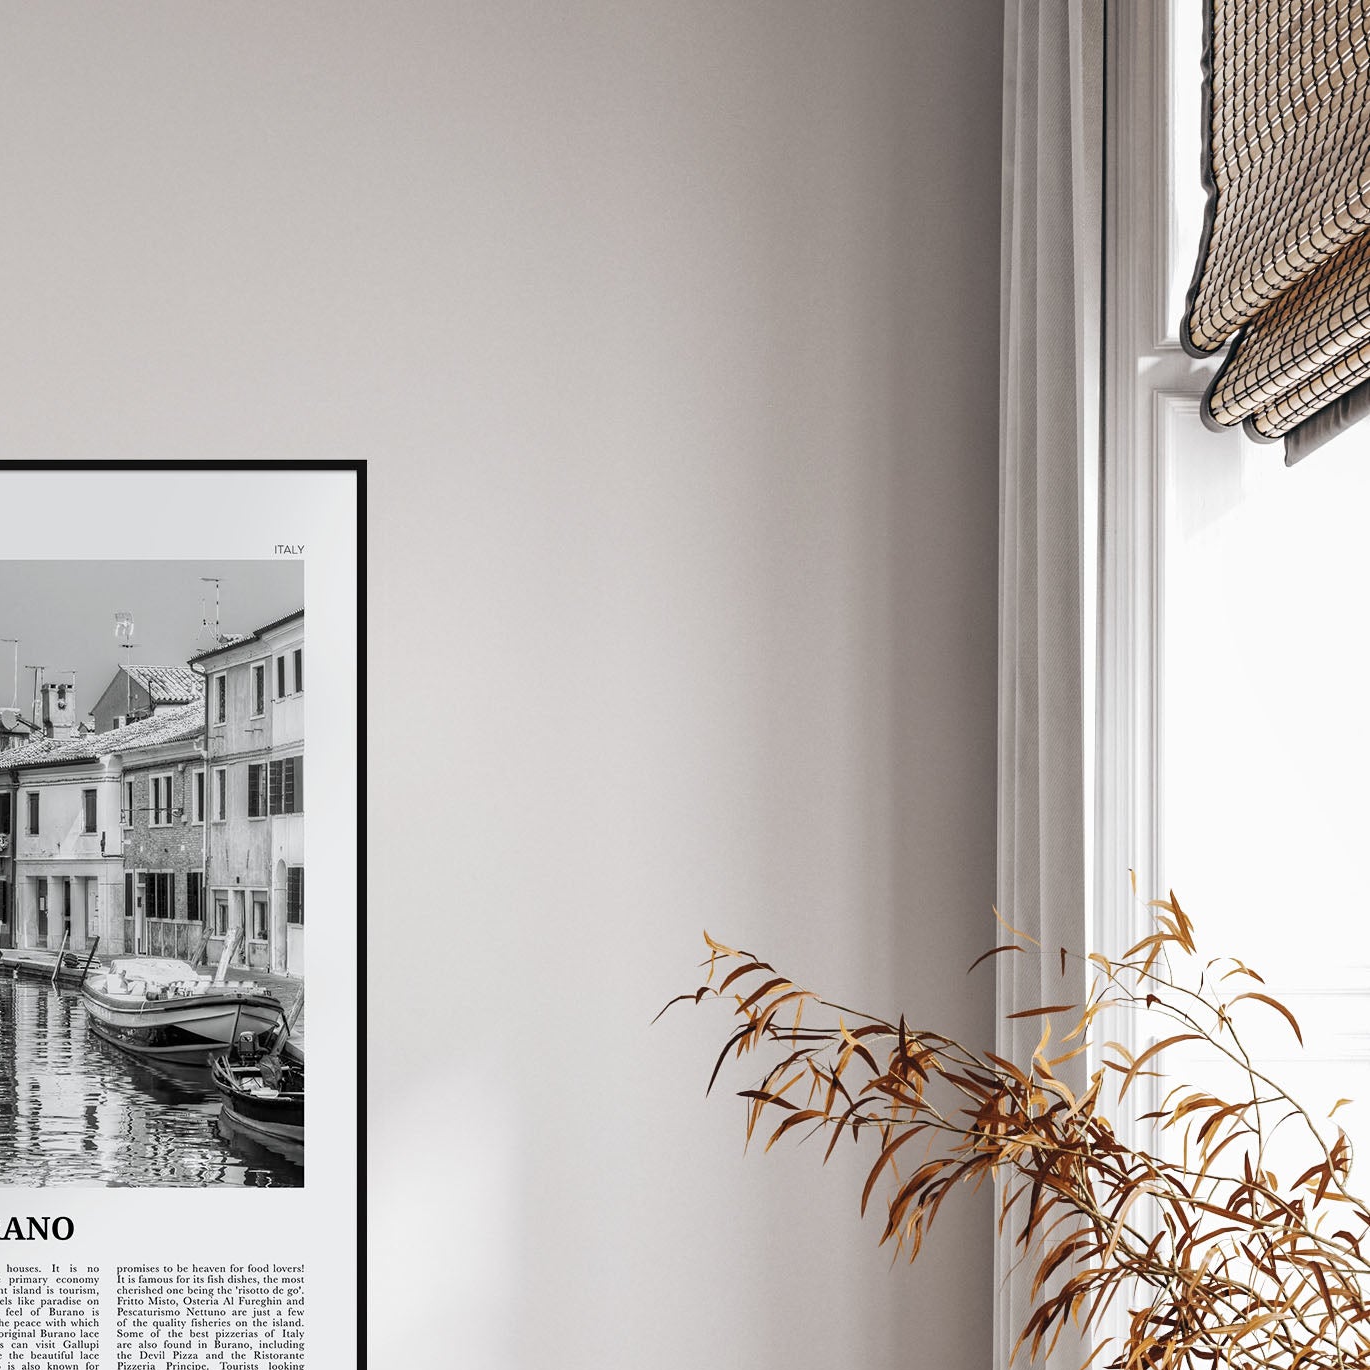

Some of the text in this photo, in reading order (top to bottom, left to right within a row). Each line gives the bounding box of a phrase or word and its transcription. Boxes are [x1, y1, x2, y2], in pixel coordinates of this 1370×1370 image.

[274, 544, 305, 555] ITALY
[7, 1264, 41, 1272] houses.
[52, 1264, 59, 1272] It
[70, 1264, 77, 1272] is
[9, 1275, 48, 1286] primary
[56, 1277, 99, 1286] economy
[13, 1285, 41, 1294] island
[47, 1285, 54, 1294] is
[59, 1285, 99, 1297] tourism,
[118, 1296, 304, 1308] Fritto Misto, Osteria Al Fureghin and
[118, 1307, 180, 1316] Pescaturismo
[187, 1307, 226, 1316] Nettuno
[254, 1307, 270, 1319] just
[288, 1307, 304, 1316] few
[117, 1318, 128, 1327] of
[133, 1318, 147, 1327] the
[153, 1318, 186, 1329] quality
[191, 1318, 230, 1327] fisheries
[253, 1318, 267, 1327] the
[273, 1318, 304, 1327] island.
[41, 1329, 76, 1338] Burano
[80, 1329, 99, 1338] lace
[36, 1340, 55, 1349] visit
[63, 1340, 99, 1351] Gallupi
[139, 1340, 157, 1349] also
[164, 1340, 191, 1349] found
[198, 1340, 207, 1349] in
[214, 1340, 252, 1351] Burano,
[259, 1340, 305, 1351] including
[9, 1351, 24, 1359] the
[31, 1351, 73, 1359] beautiful
[80, 1351, 99, 1359] lace
[117, 1351, 304, 1359] the Devil Pizza and the Ristorante
[8, 1362, 15, 1370] is
[22, 1362, 40, 1370] also
[47, 1362, 78, 1370] known
[86, 1362, 99, 1370] for
[118, 1362, 155, 1370] Pizzeria
[219, 1362, 258, 1370] Tourists
